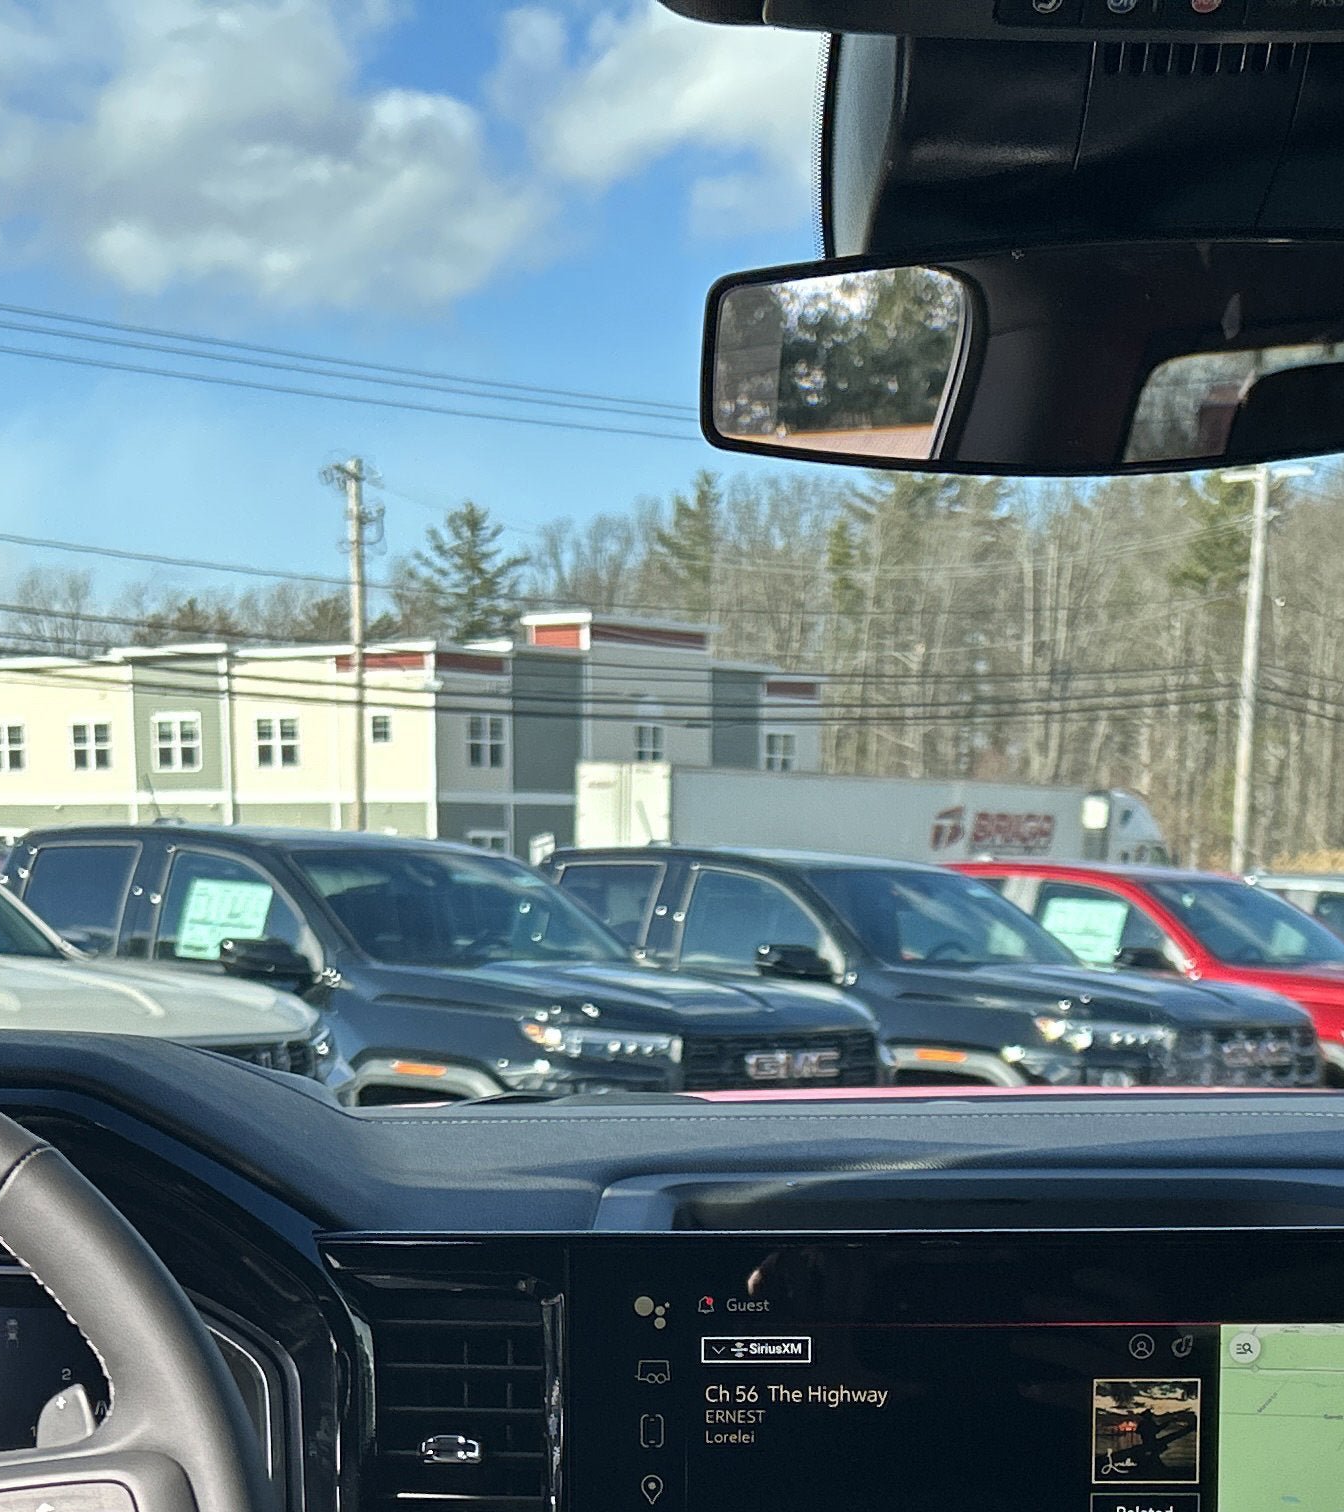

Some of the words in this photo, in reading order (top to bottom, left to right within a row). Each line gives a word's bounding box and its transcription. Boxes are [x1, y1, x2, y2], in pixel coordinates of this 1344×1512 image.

[744, 1049, 840, 1079] GMC
[726, 1298, 770, 1313] Guest
[749, 1342, 802, 1356] SiriusXM
[61, 1368, 72, 1381] 2
[705, 1386, 730, 1403] Ch
[735, 1386, 758, 1403] 56
[768, 1386, 803, 1403] The
[808, 1386, 888, 1408] Highway
[706, 1410, 766, 1424] ERNEST
[706, 1430, 755, 1444] Lorelei
